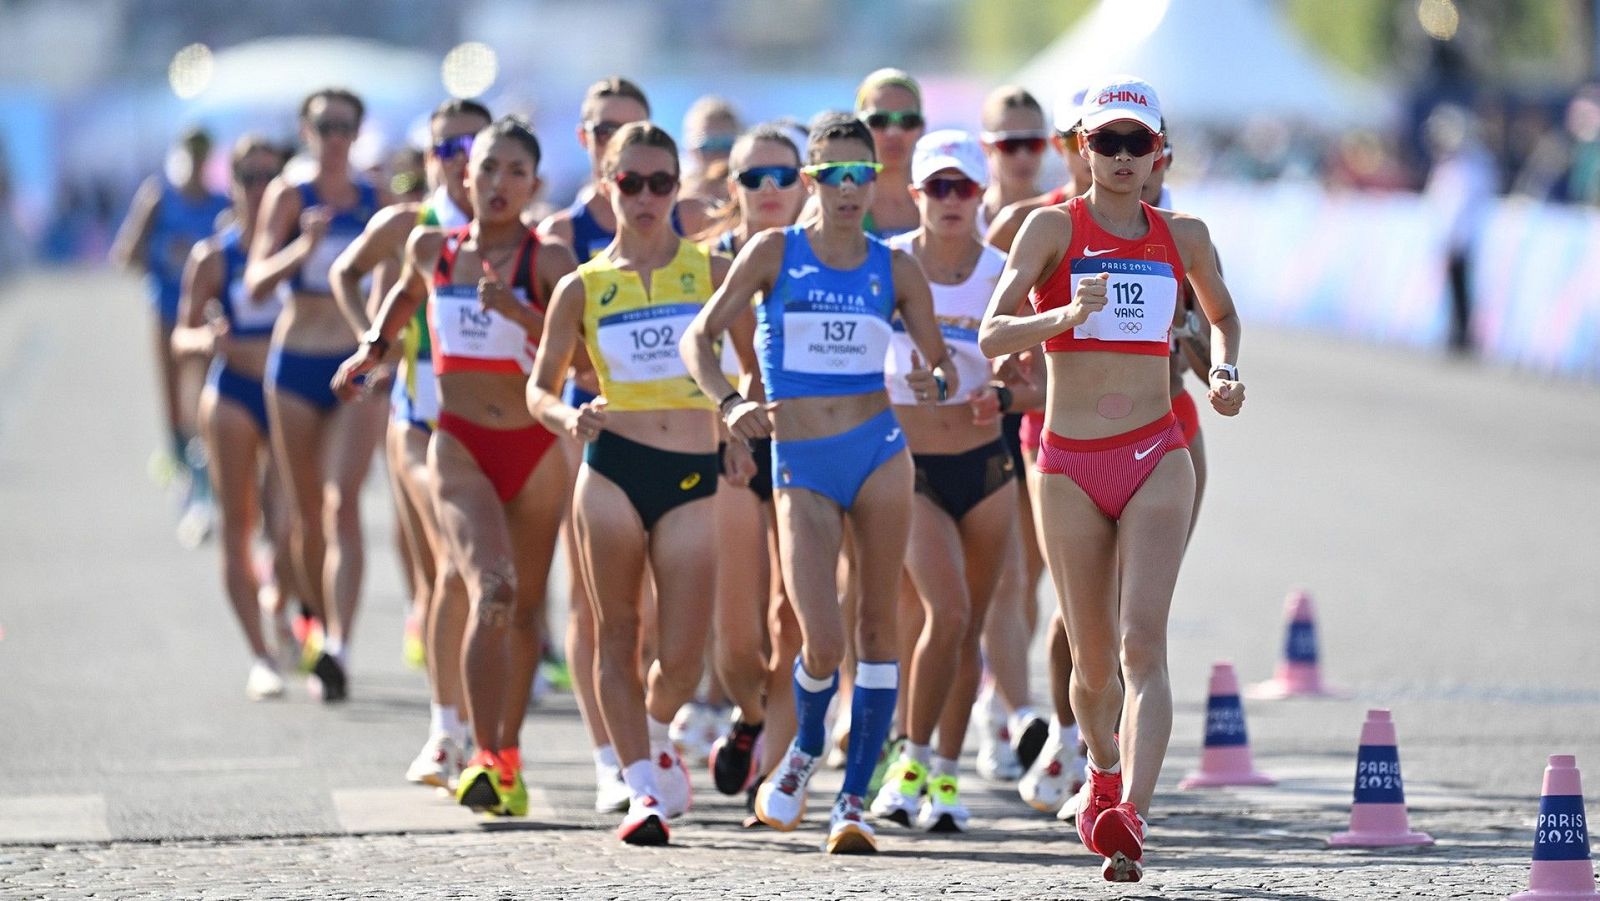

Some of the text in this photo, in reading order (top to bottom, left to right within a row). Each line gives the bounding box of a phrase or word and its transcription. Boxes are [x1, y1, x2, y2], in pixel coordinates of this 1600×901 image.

[1098, 91, 1147, 106] CHINA
[1130, 263, 1152, 271] 2024
[808, 289, 865, 306] ITALIA
[1113, 282, 1145, 305] 112
[1114, 308, 1145, 318] YANG
[630, 324, 675, 350] 102
[822, 321, 857, 341] 137
[1359, 775, 1401, 789] 2024
[1539, 829, 1584, 844] 2024
